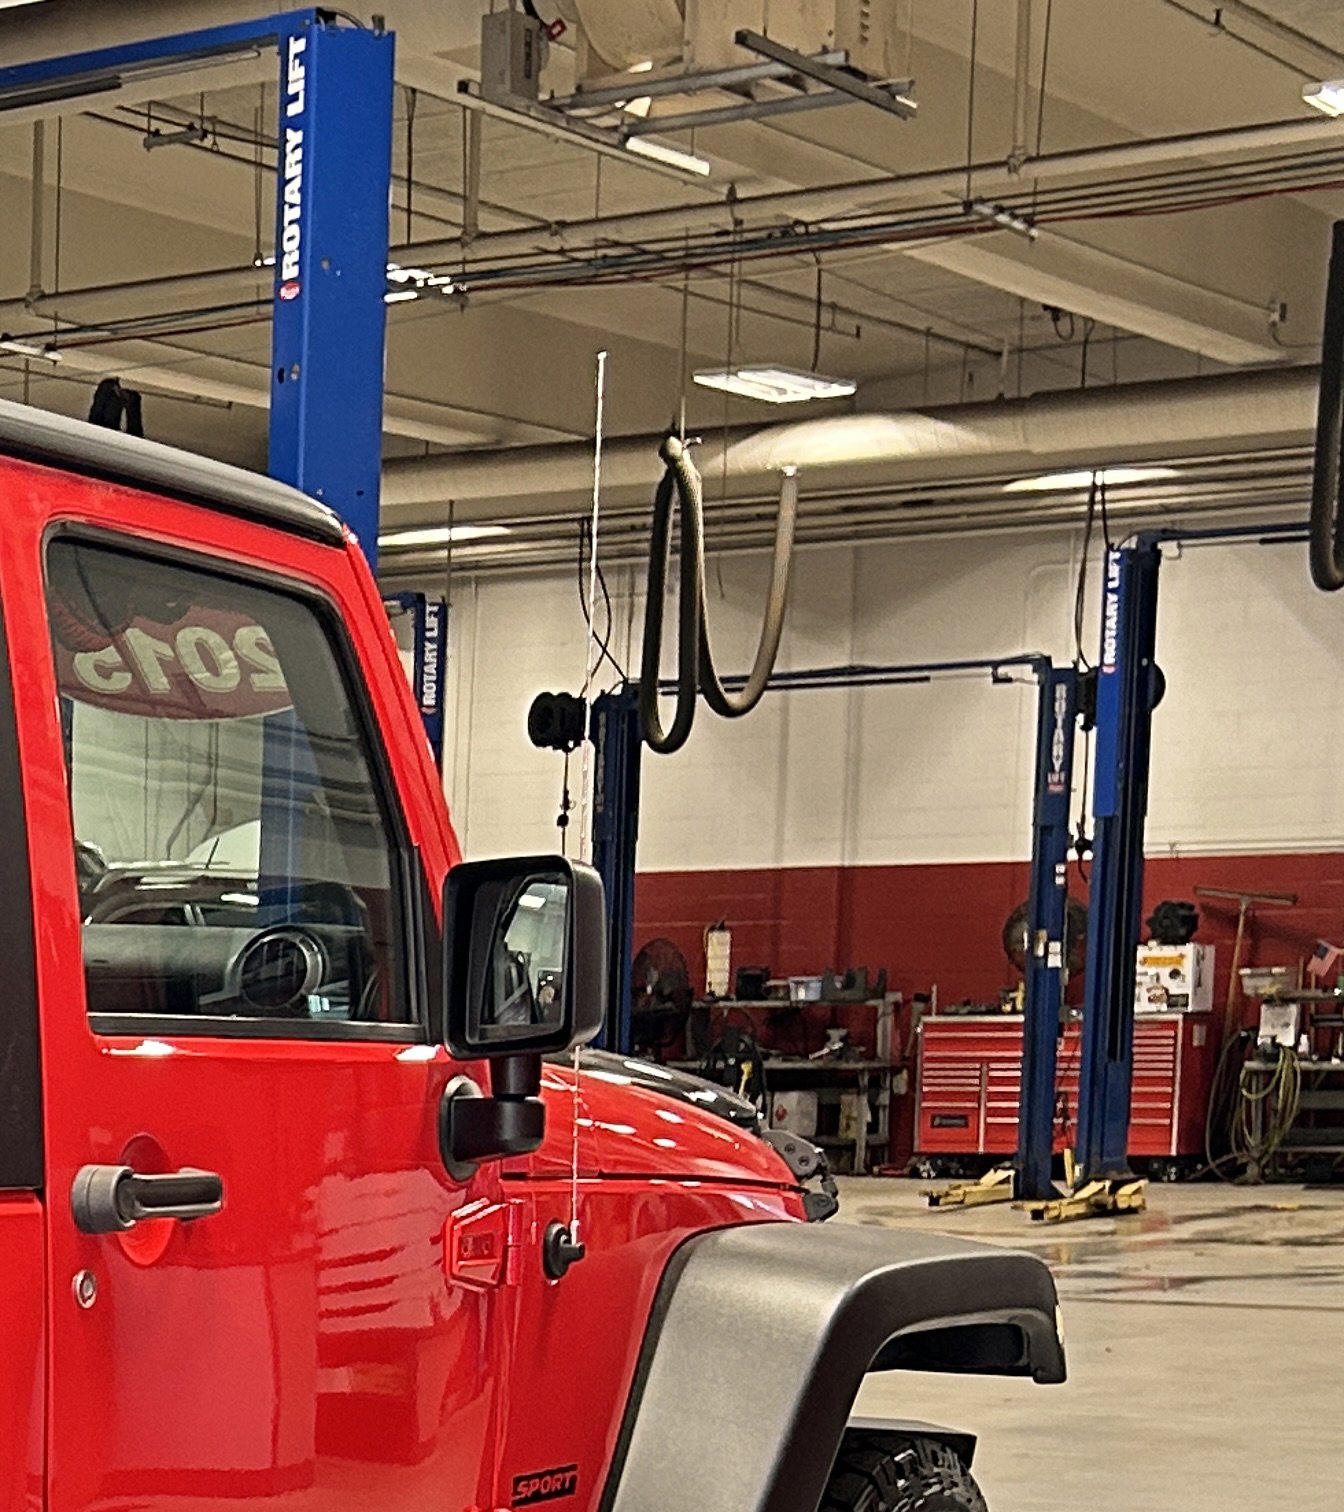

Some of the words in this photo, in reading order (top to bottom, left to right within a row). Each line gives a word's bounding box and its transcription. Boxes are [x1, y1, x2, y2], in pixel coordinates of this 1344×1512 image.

[286, 36, 307, 118] LIFT
[282, 128, 304, 280] ROTARY
[425, 603, 440, 639] LIFT
[1103, 592, 1119, 665] ROTARY
[423, 641, 439, 707] ROTARY
[513, 1470, 575, 1501] SPORT
